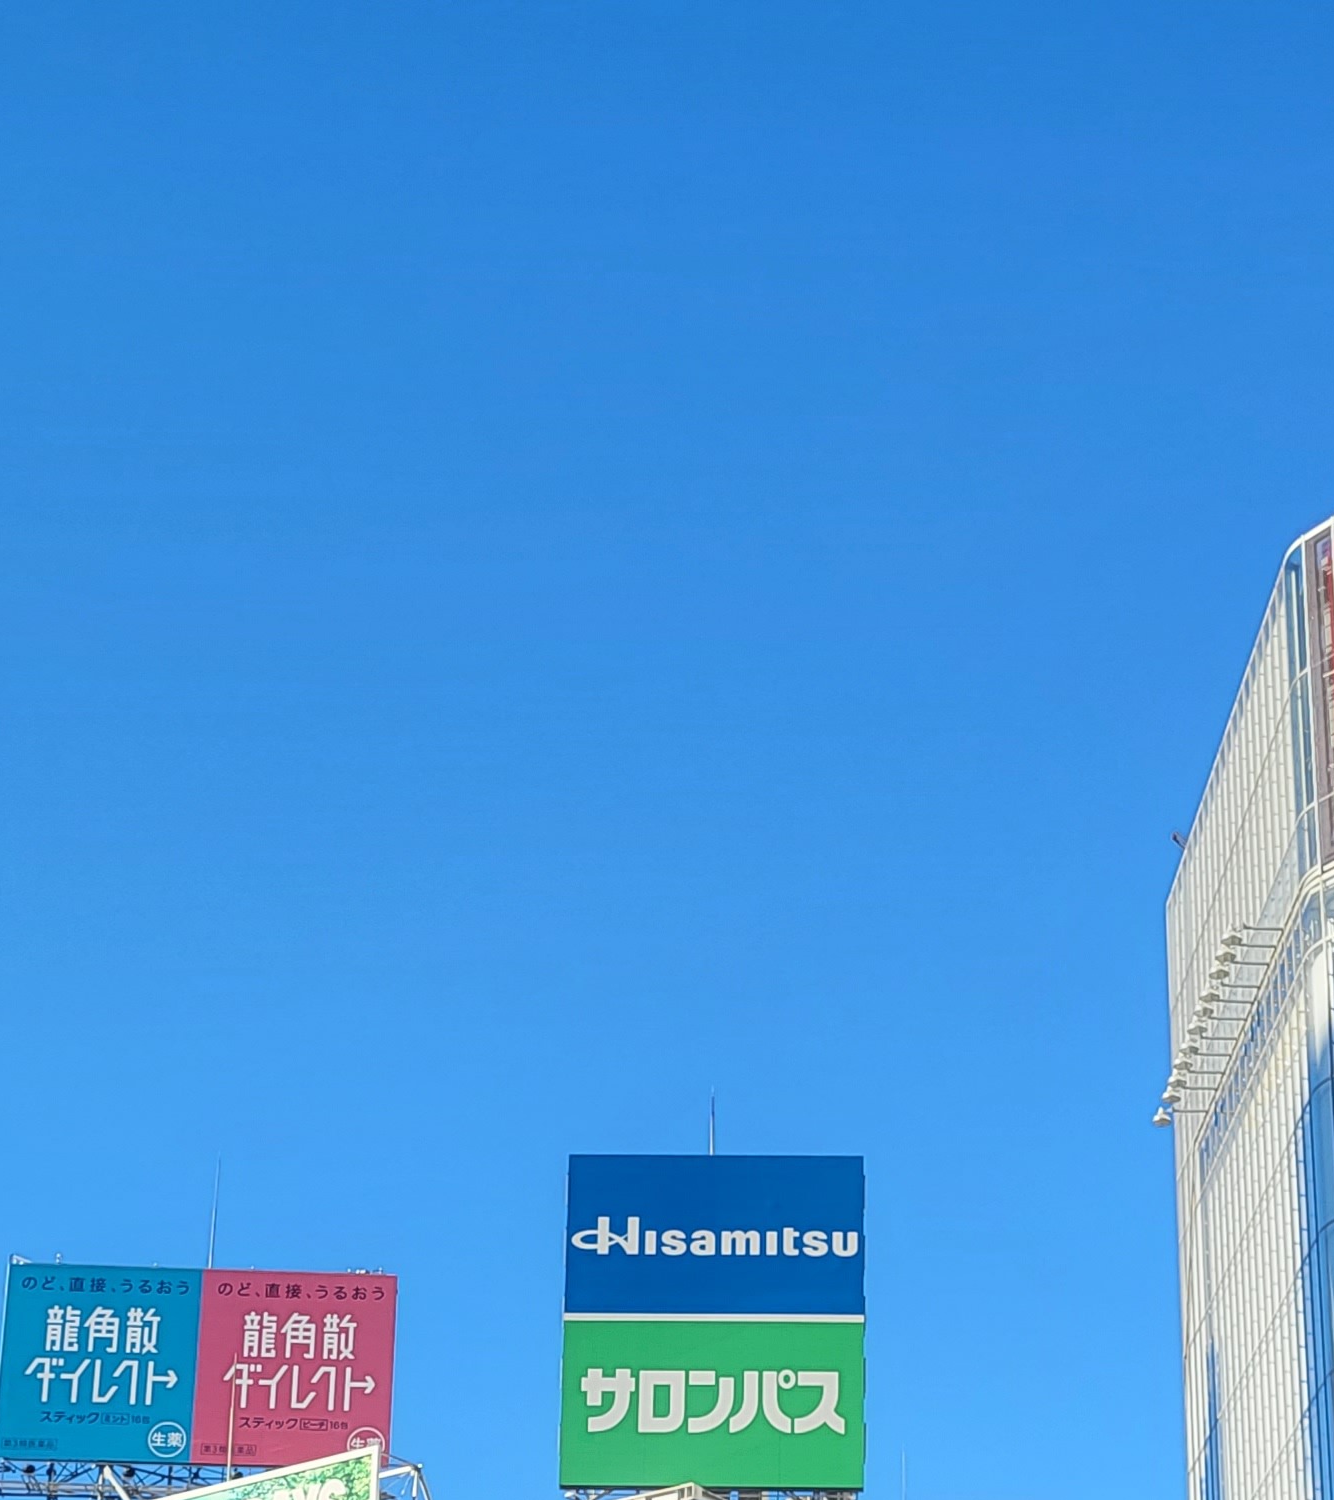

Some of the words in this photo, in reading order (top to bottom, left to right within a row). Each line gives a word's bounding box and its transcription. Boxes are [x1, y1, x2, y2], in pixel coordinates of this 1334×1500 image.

[571, 1216, 860, 1259] Hisamitsu
[21, 1276, 190, 1296] のど、直接、うるおう
[217, 1281, 386, 1301] のど、直接、うるおう
[44, 1305, 161, 1354] 龍角散
[242, 1311, 357, 1361] 龍角散
[24, 1357, 178, 1406] ダイレクト
[222, 1364, 376, 1413] ダイレクト
[580, 1367, 847, 1436] サロンパス
[39, 1411, 100, 1425] スティック
[151, 1431, 183, 1448] 生薬
[238, 1417, 298, 1430] スティック
[301, 1420, 327, 1430] ピーチ
